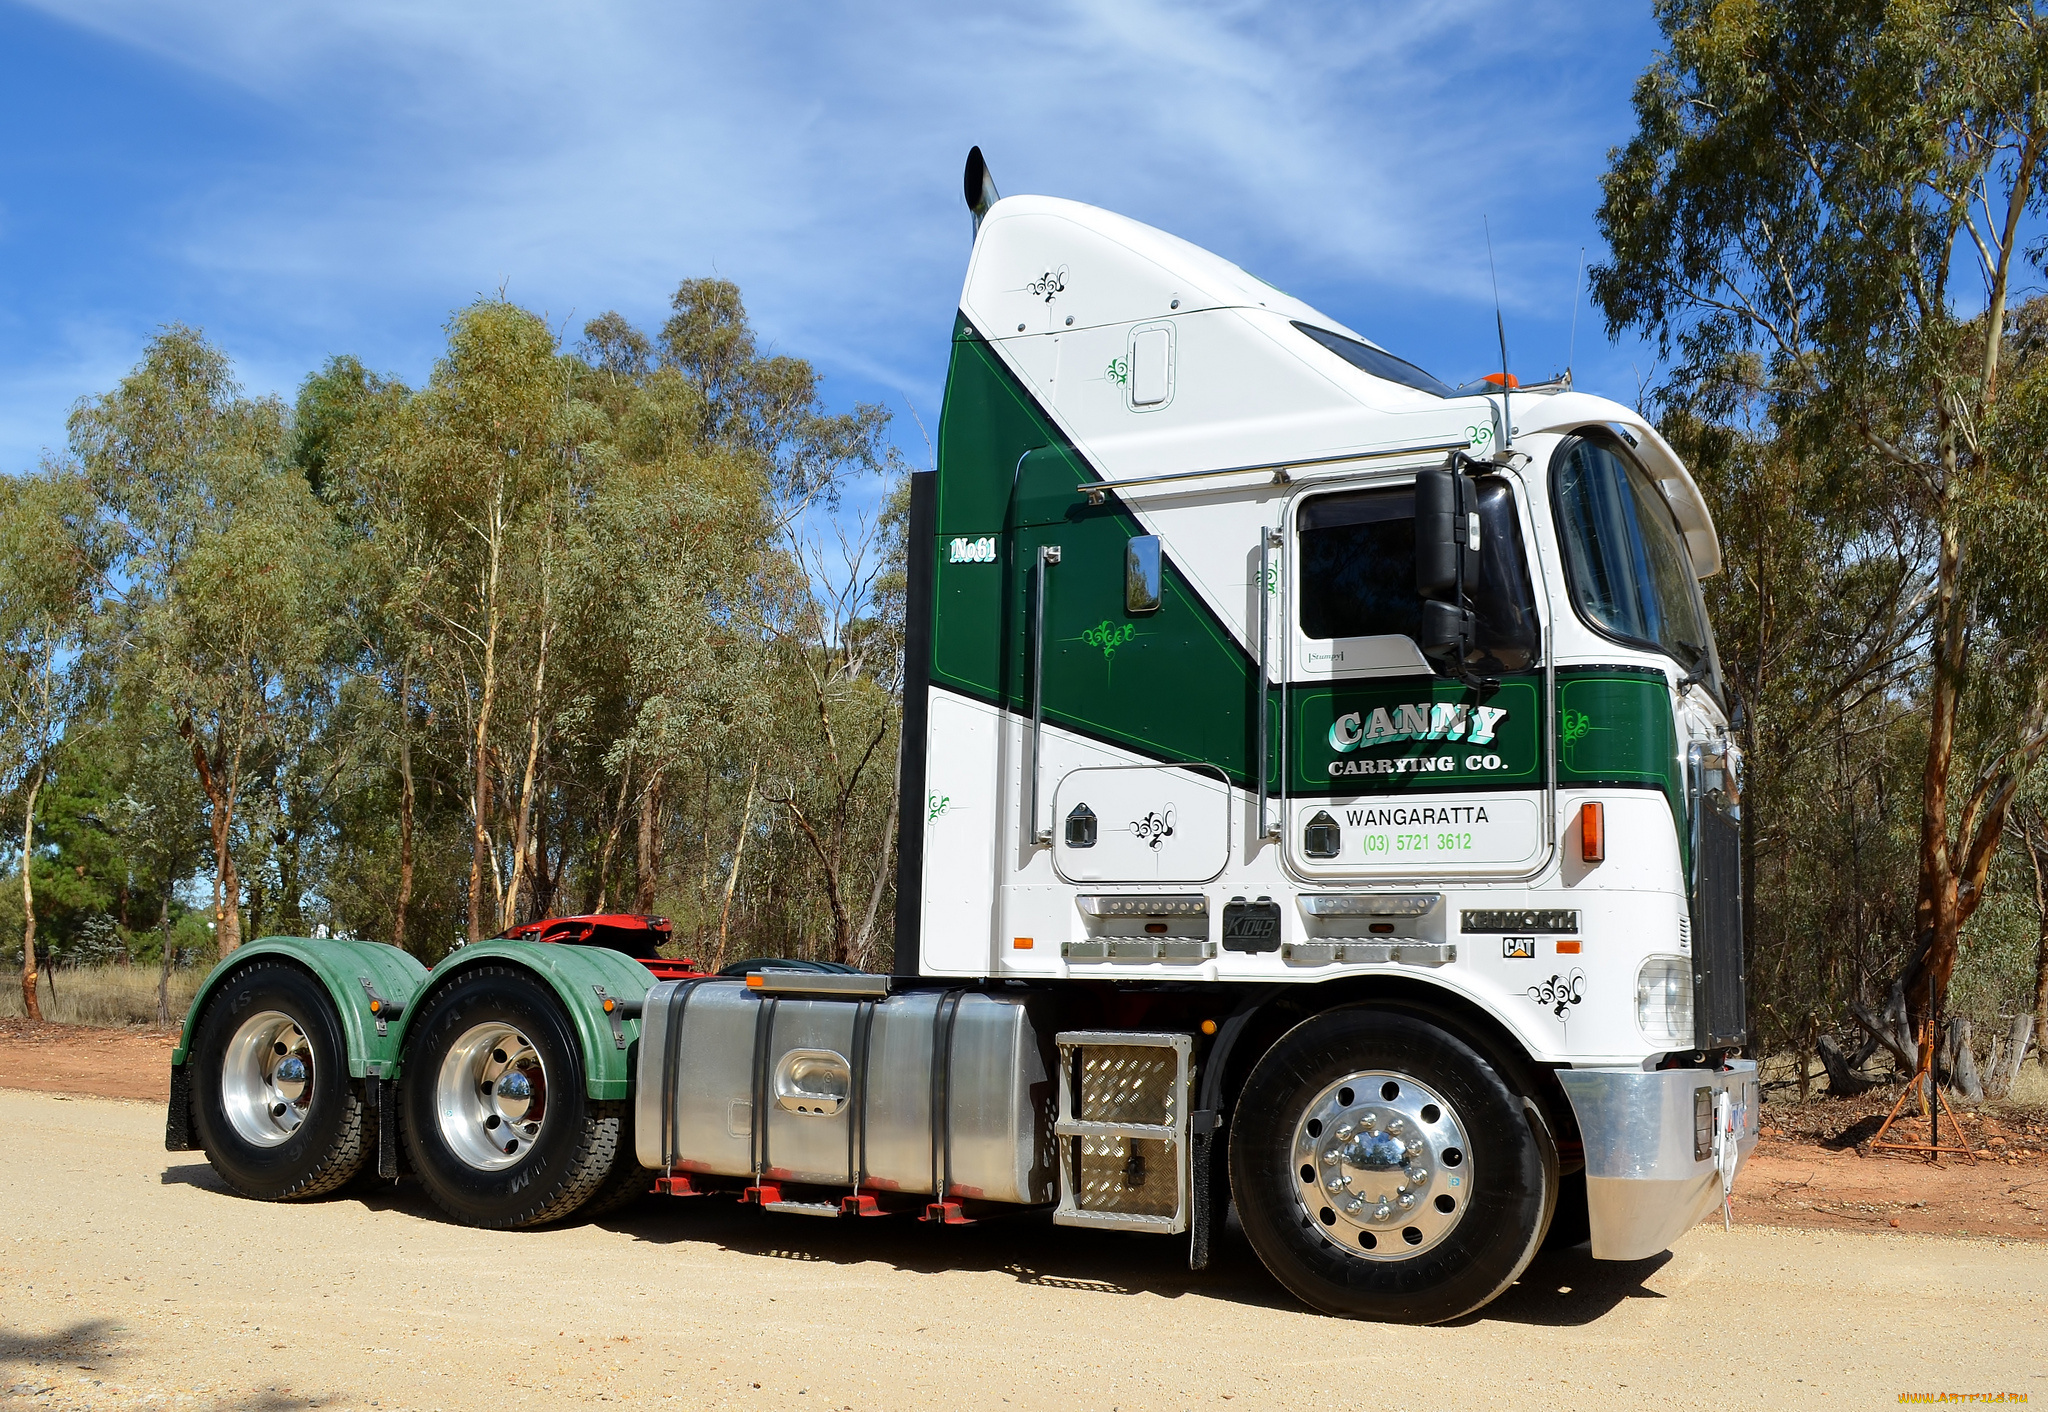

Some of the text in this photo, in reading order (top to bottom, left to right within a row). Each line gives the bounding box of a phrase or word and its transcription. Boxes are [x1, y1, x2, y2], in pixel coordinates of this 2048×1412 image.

[1328, 702, 1508, 753] CANNY
[1328, 755, 1508, 776] CARRYING CO.
[1346, 806, 1489, 827] WANGARATTA
[1363, 833, 1472, 855] (03) 5721 3612
[1461, 910, 1578, 929] KENWORTH
[1504, 938, 1534, 956] CAT
